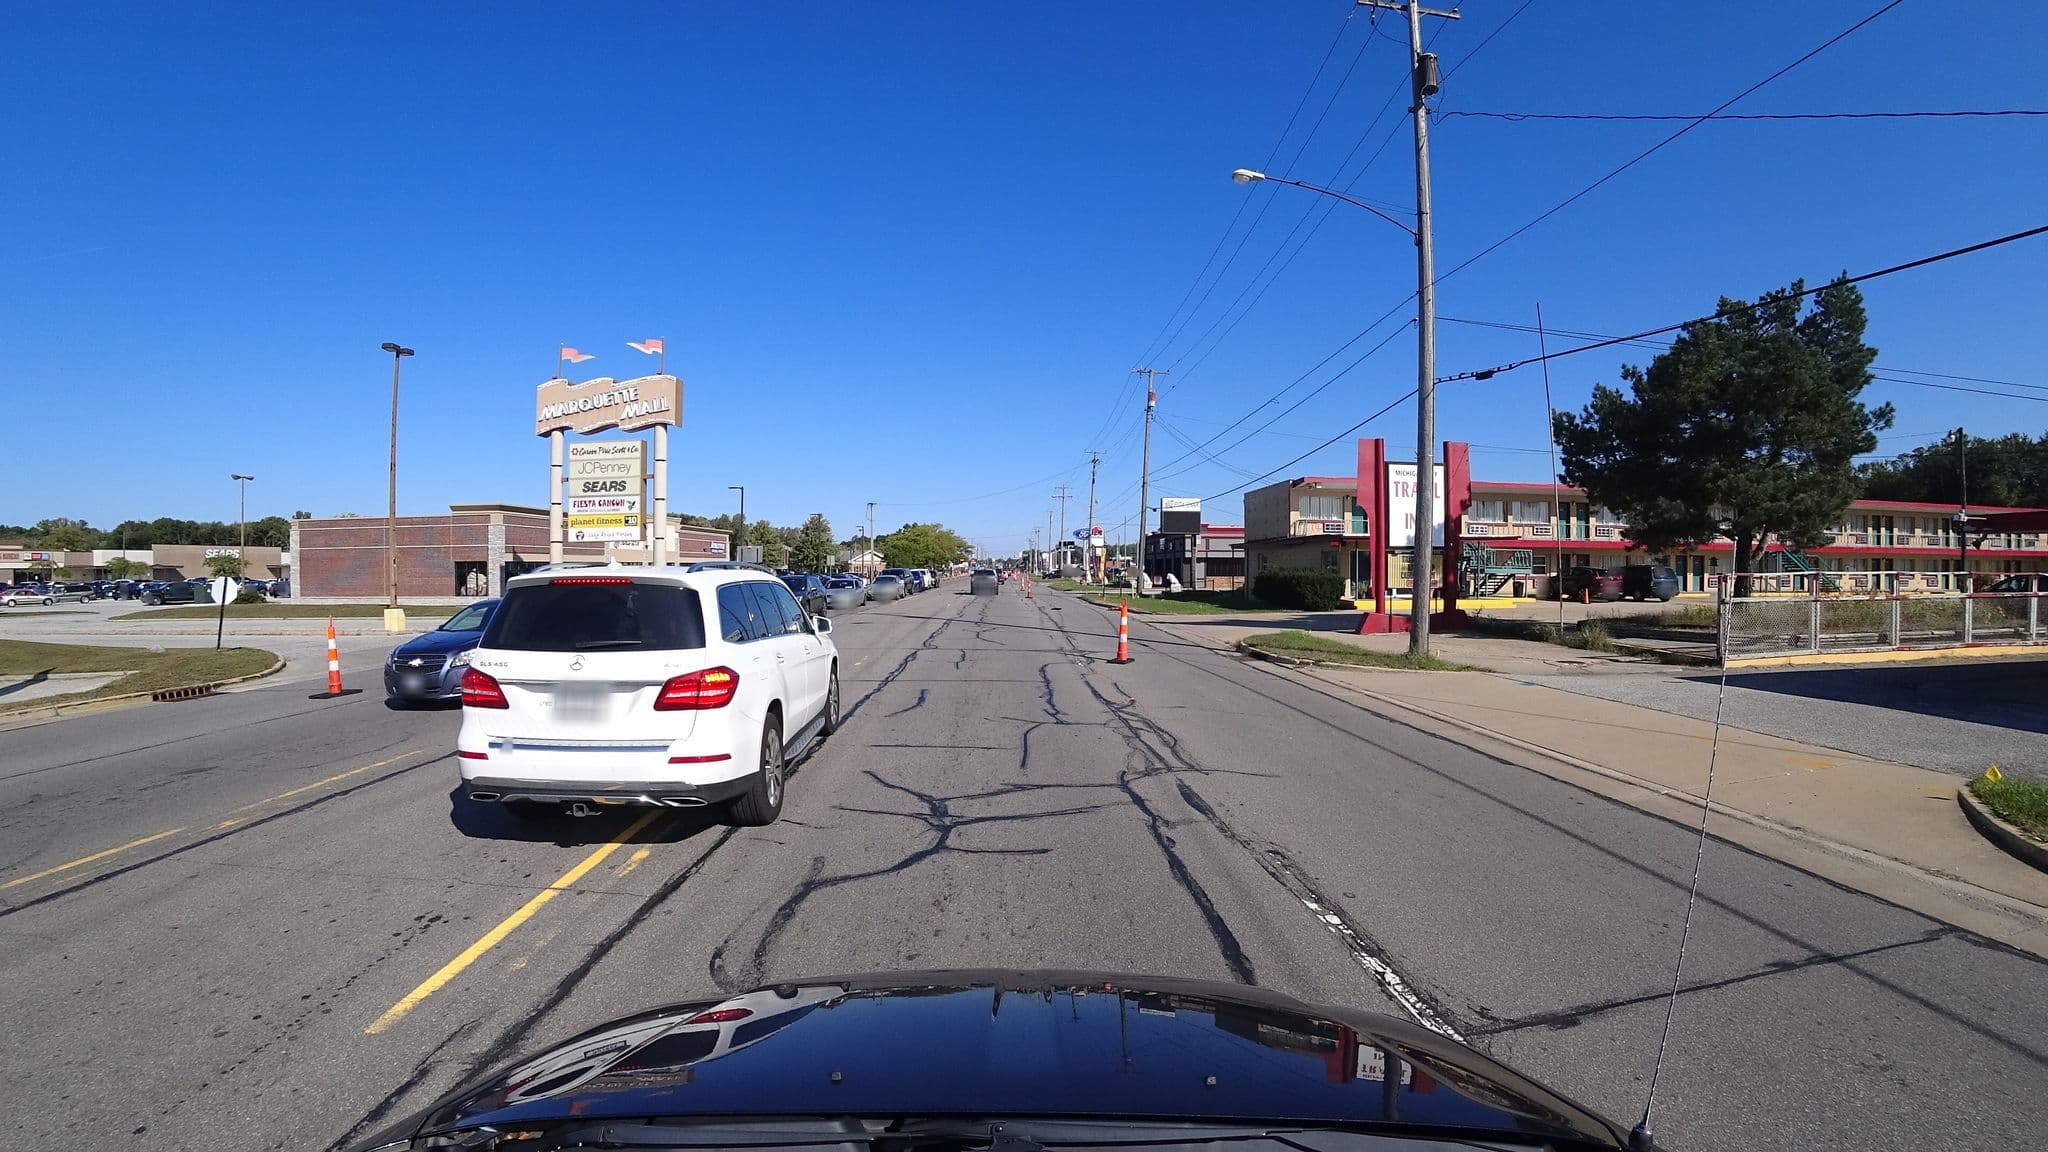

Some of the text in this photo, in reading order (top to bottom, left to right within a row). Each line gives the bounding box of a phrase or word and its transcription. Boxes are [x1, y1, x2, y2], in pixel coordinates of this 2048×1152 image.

[537, 387, 639, 422] MARQUETTE
[619, 397, 670, 420] MALL
[577, 461, 632, 475] JCPenney
[582, 480, 627, 493] SEARS
[573, 499, 597, 509] FIESTA
[571, 515, 623, 528] planet fitness
[204, 548, 240, 559] SEARS
